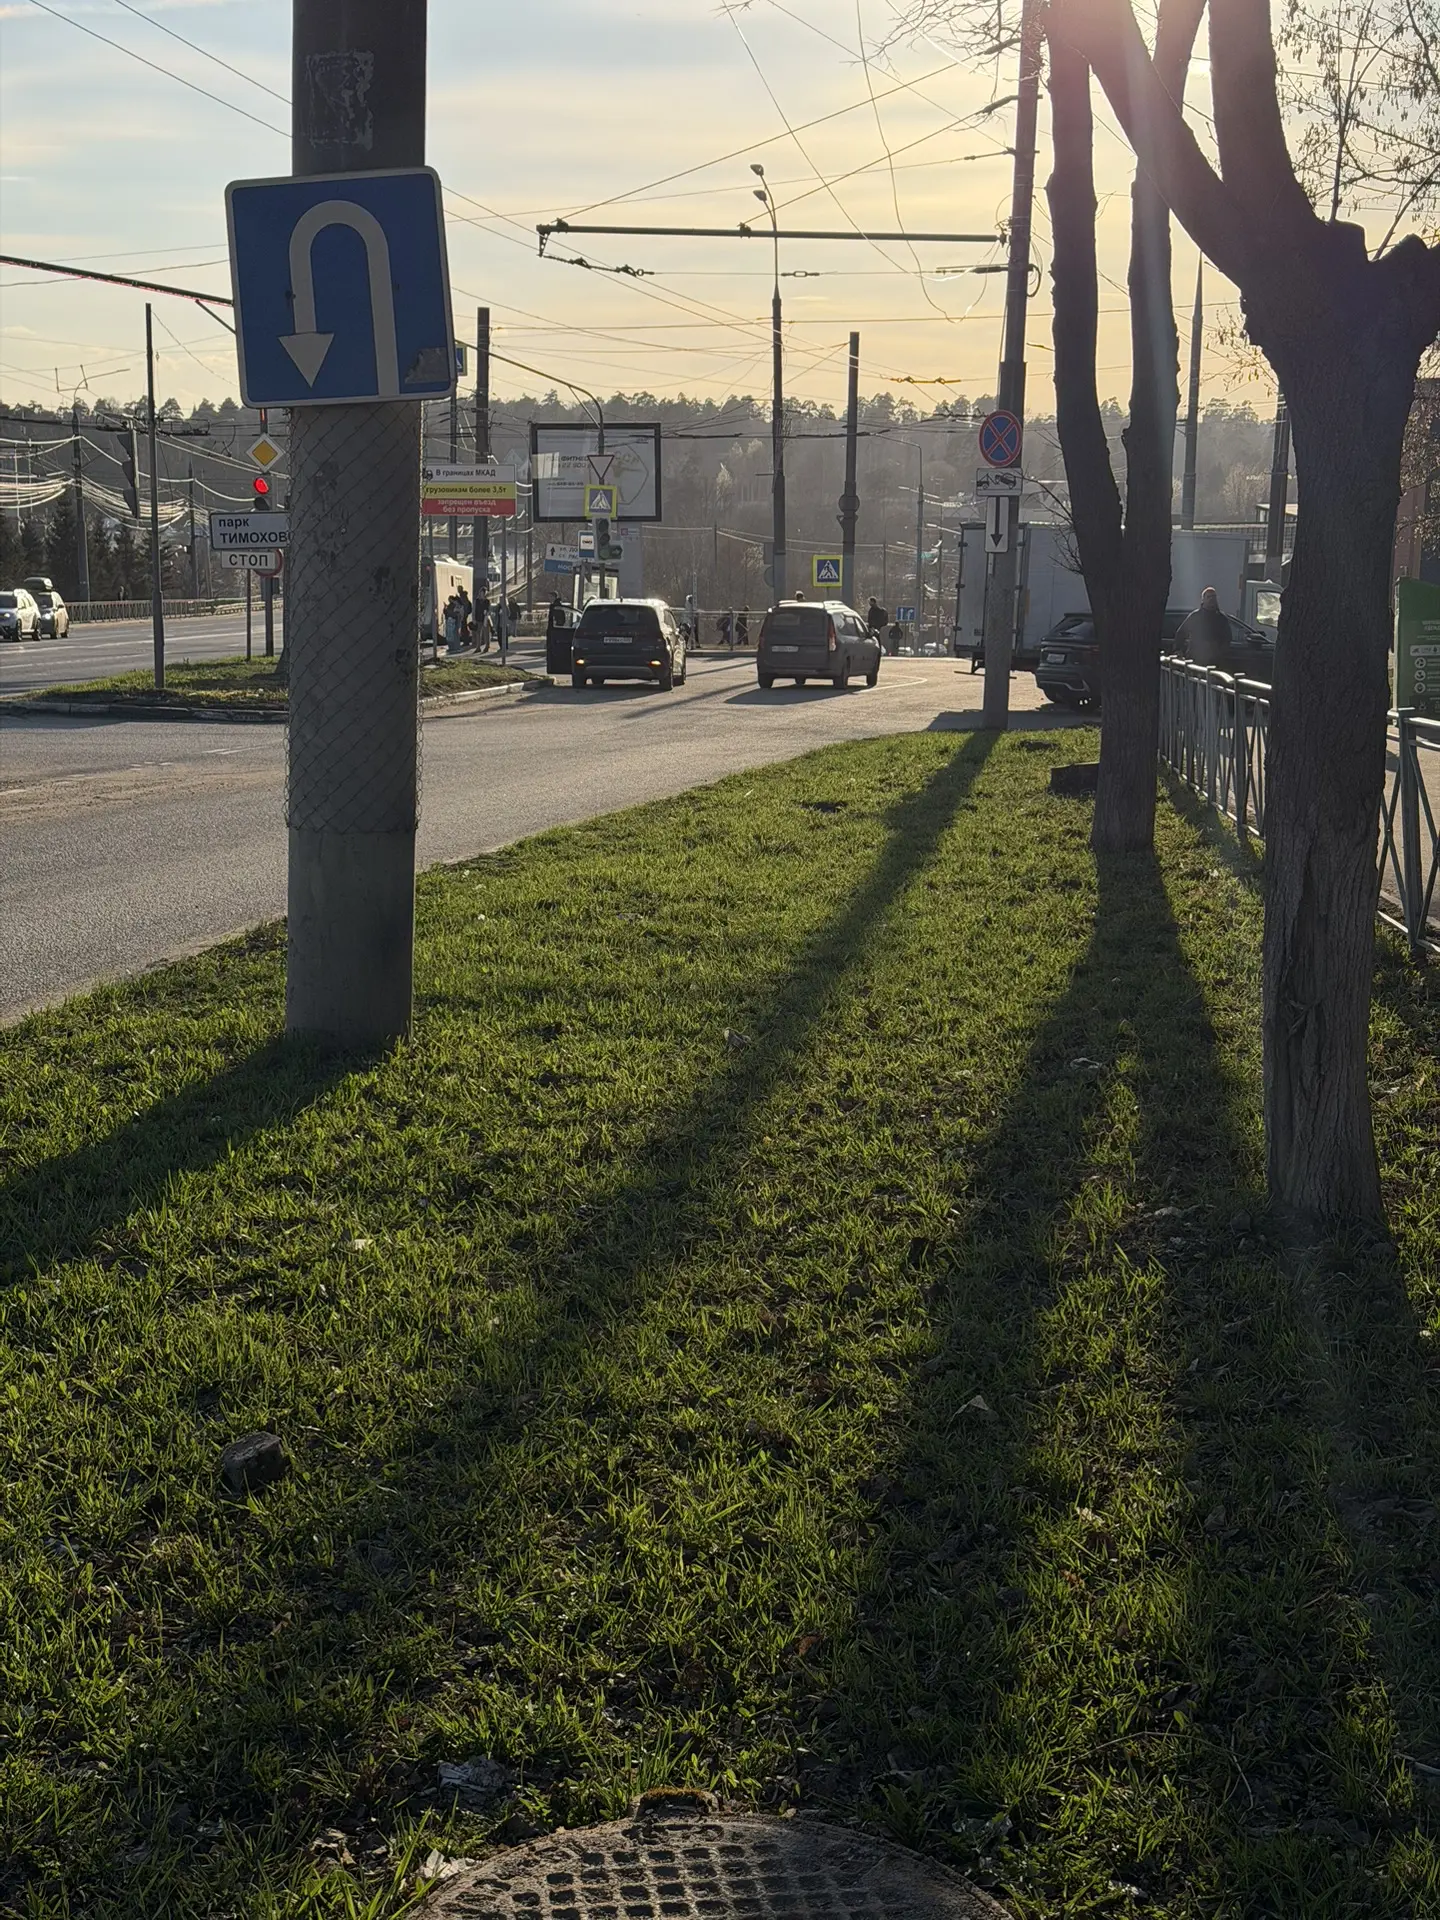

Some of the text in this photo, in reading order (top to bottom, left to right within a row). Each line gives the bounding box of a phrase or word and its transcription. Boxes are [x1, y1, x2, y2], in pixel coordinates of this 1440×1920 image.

[475, 469, 496, 477] МКАД
[218, 518, 250, 529] парк
[220, 531, 290, 544] ТИМОХОВ
[229, 554, 268, 566] СТОП
